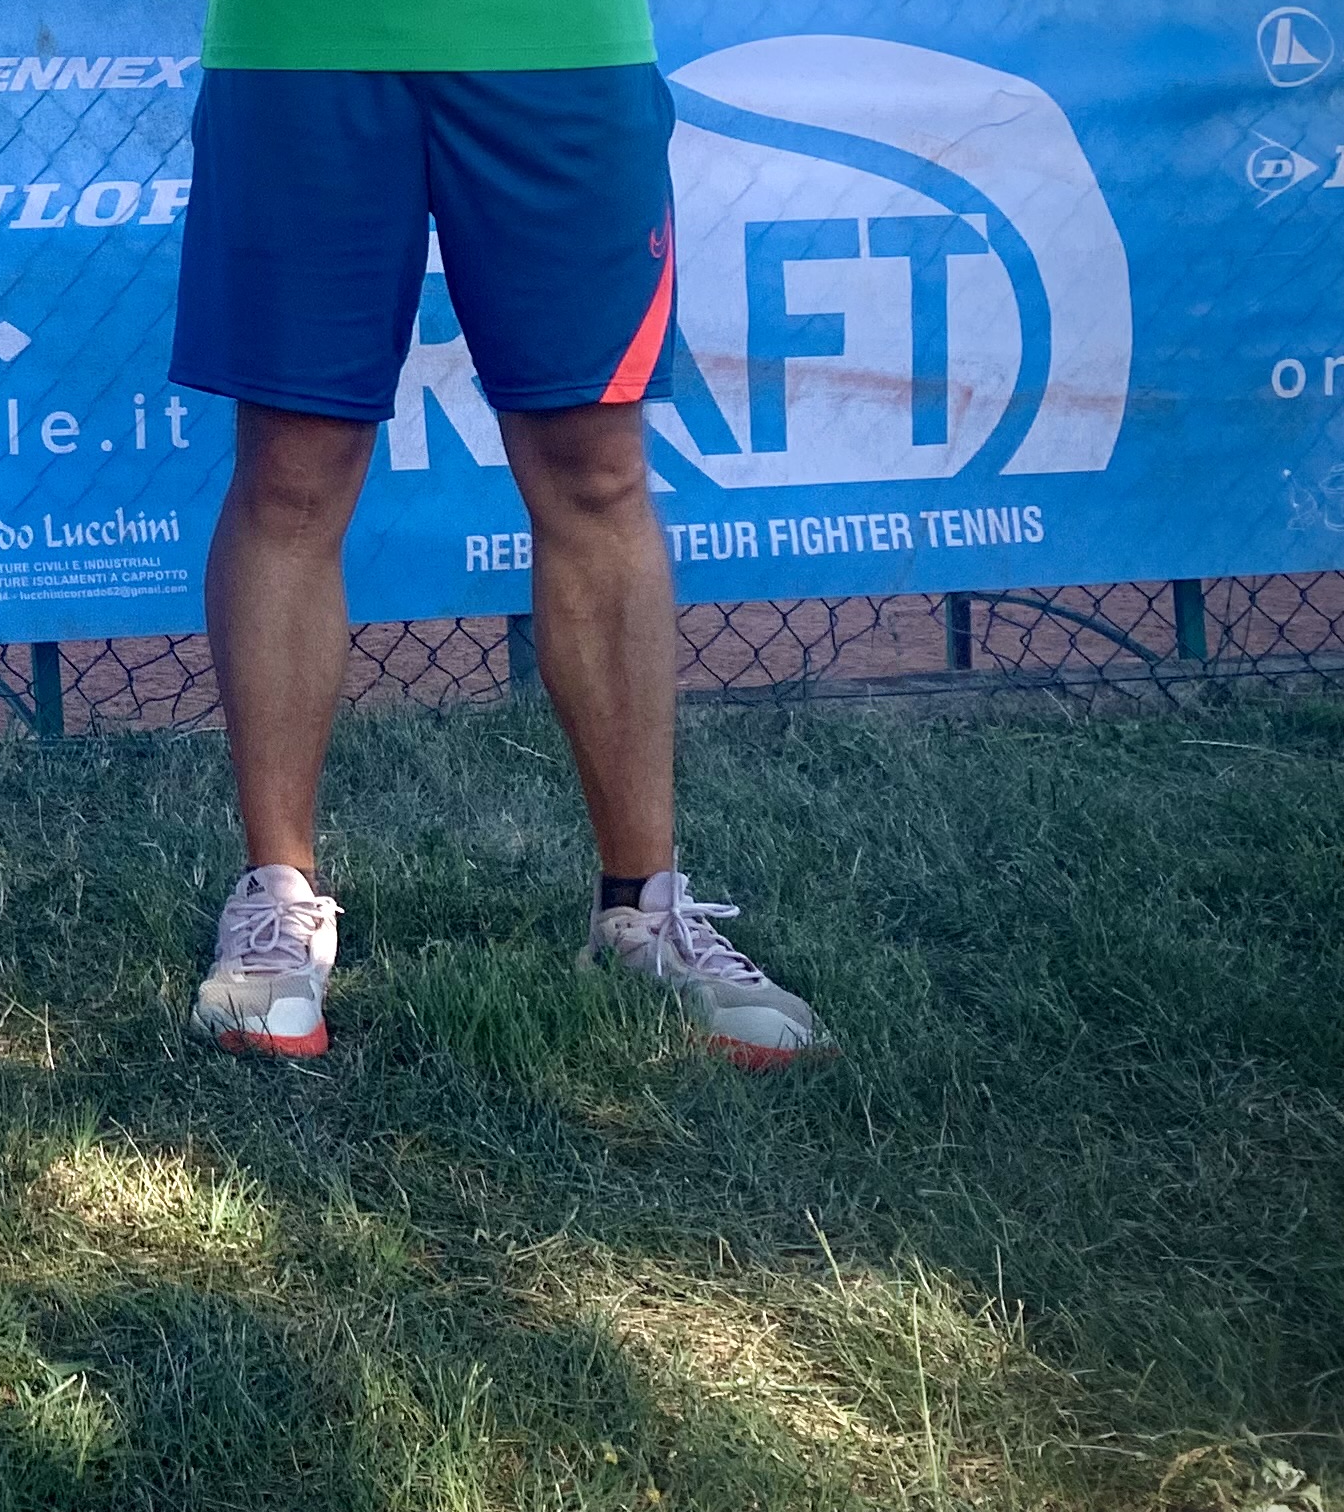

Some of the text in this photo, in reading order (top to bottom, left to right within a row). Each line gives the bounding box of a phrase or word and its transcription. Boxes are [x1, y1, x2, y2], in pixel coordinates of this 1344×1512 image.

[43, 506, 181, 549] Lucchini
[768, 512, 913, 556] FIGHTER
[920, 504, 1045, 549] TENNIS
[32, 571, 108, 587] ISOLAMENTI
[110, 571, 119, 583] A
[121, 568, 188, 583] CAPPOTTO
[72, 559, 81, 570] E
[84, 556, 161, 570] INDUSTRIALI
